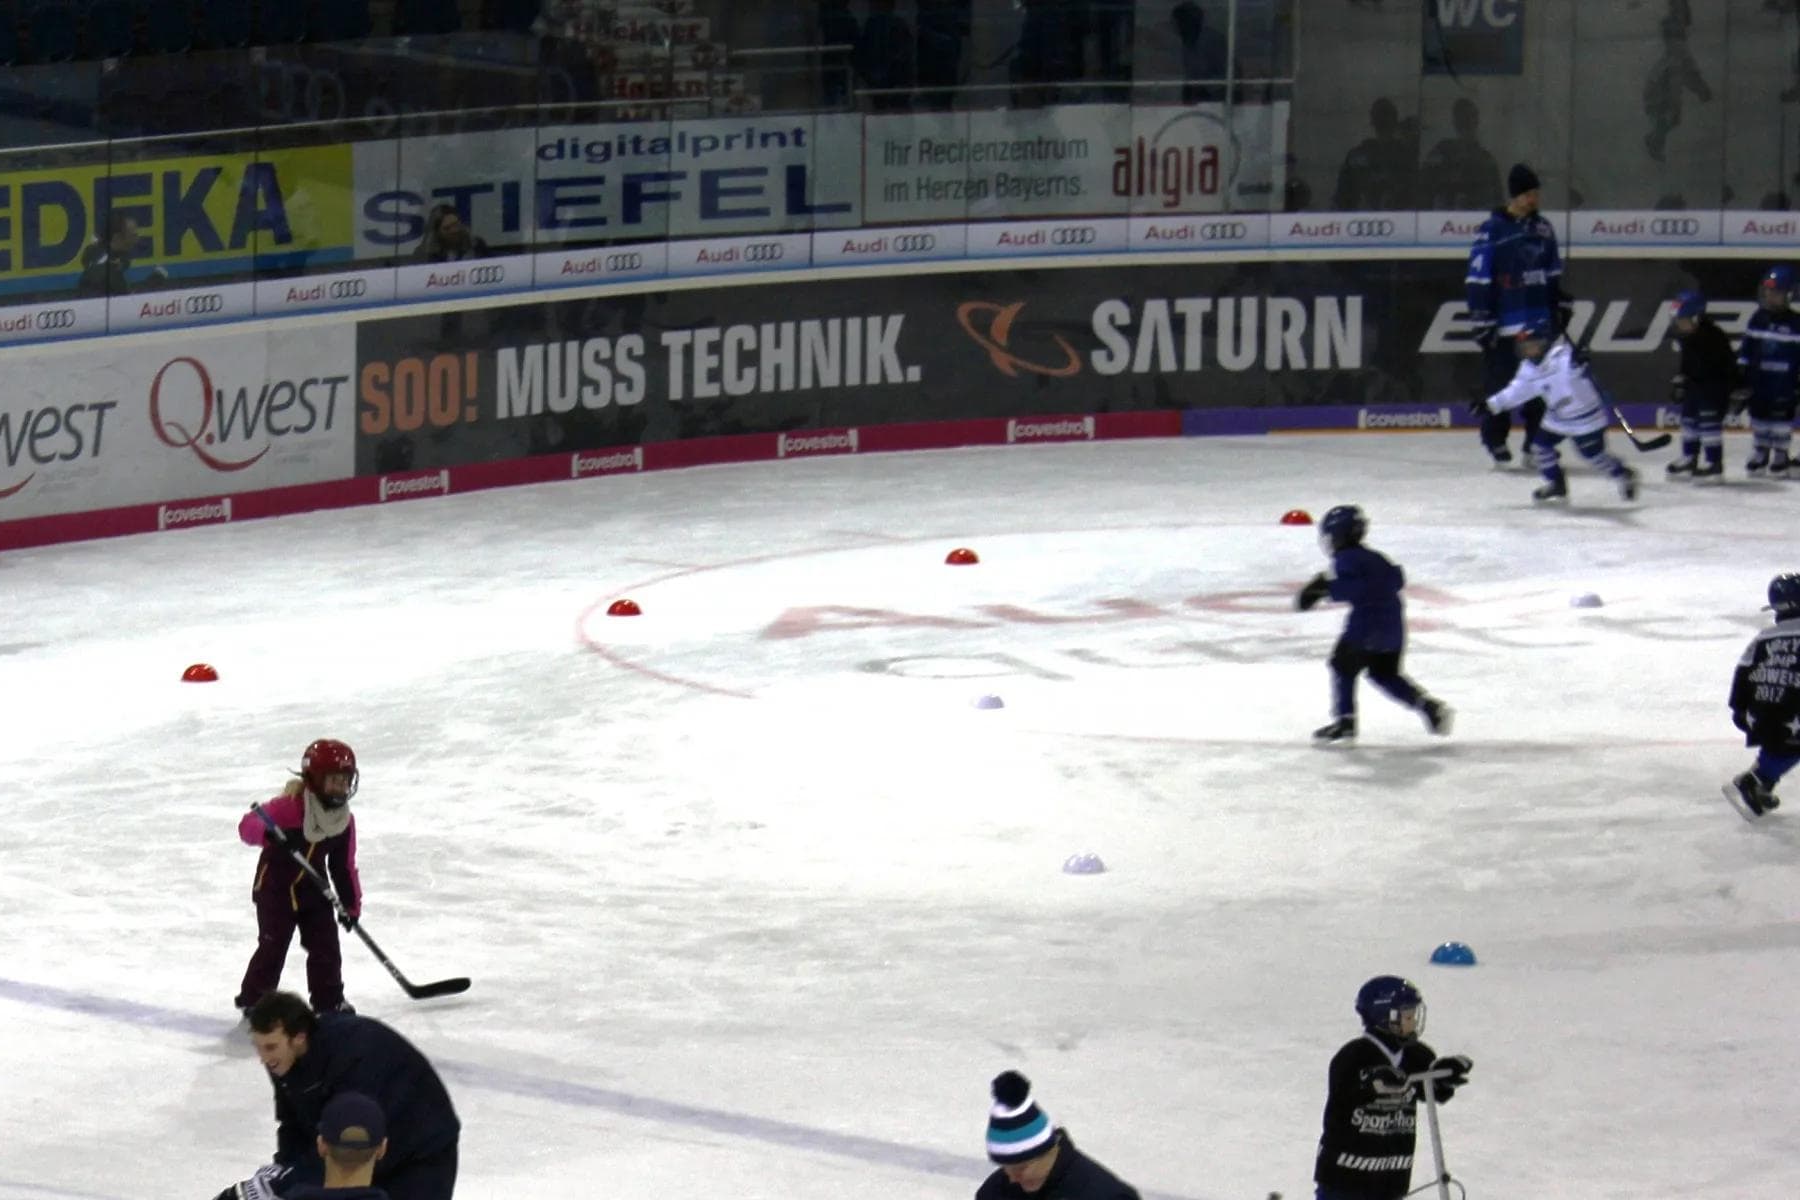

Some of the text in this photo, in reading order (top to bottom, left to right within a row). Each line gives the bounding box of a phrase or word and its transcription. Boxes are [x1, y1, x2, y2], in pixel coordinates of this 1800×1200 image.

[536, 126, 808, 165] digitalprint
[883, 135, 1089, 167] Ihr Rechenzentrum
[883, 178, 911, 203] im
[916, 174, 989, 201] Herzen
[363, 164, 852, 246] STIEFEL
[1144, 223, 1195, 241] Audi
[1289, 220, 1342, 239] Audi
[1591, 217, 1645, 236] Audi
[1742, 217, 1797, 236] Audi
[841, 237, 889, 256] Audi
[997, 229, 1047, 247] Audi
[696, 246, 740, 265] Audi
[561, 258, 601, 276] Audi
[426, 271, 466, 290] Audi
[286, 284, 327, 304] Audi
[139, 299, 183, 320] Audi
[1090, 295, 1364, 375] SATURN
[360, 313, 923, 435] SOO! MUSS TECHNIK.
[1012, 418, 1086, 440] covestro
[1364, 411, 1443, 429] covestro
[783, 432, 853, 455] covestro
[577, 451, 637, 474] covestro
[385, 474, 442, 498] covestro
[164, 501, 223, 526] covestro
